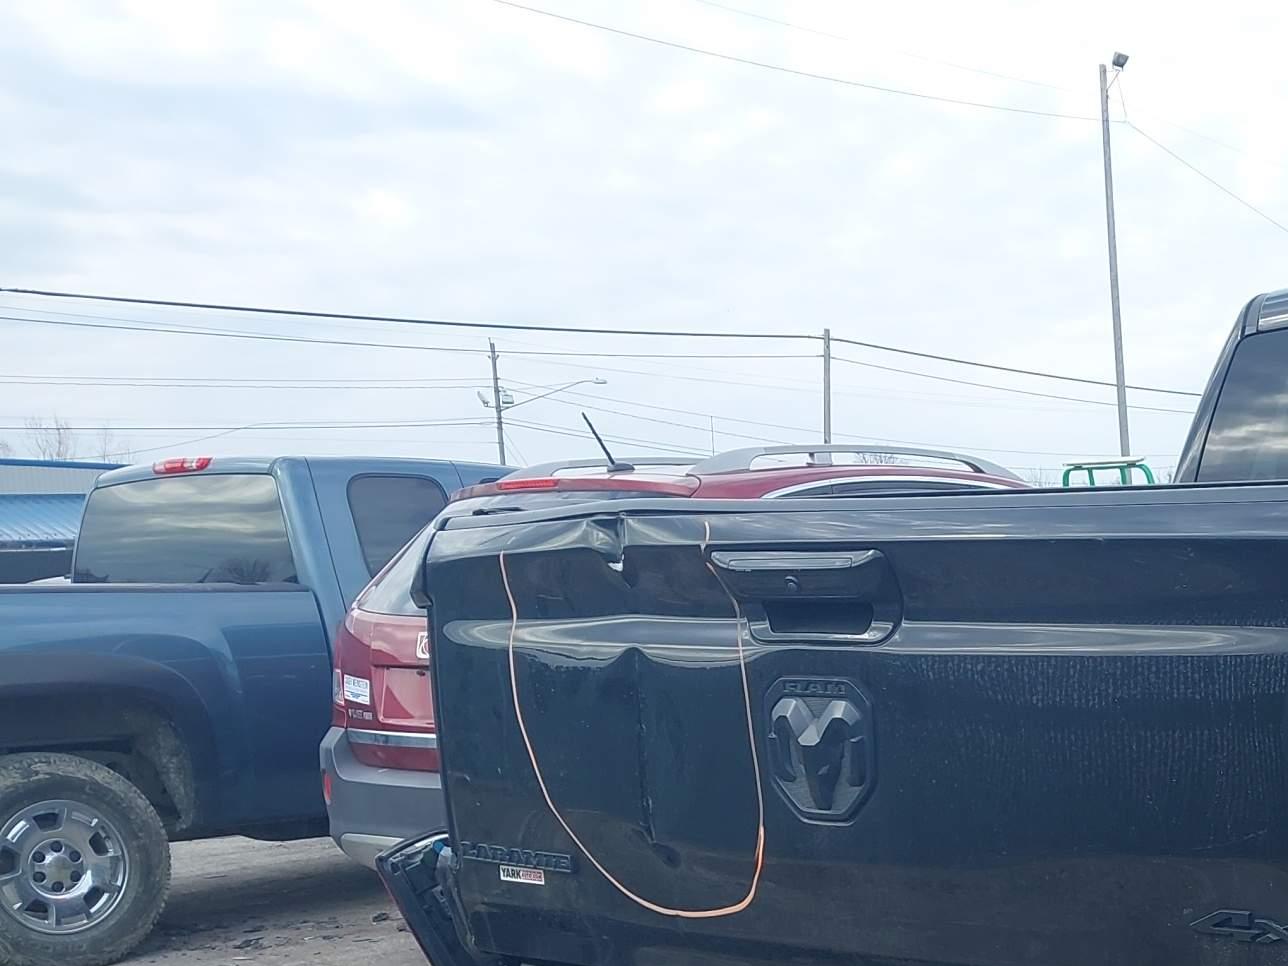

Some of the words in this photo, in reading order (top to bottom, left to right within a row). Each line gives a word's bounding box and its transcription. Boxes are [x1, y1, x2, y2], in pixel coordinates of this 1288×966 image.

[784, 682, 845, 695] RAM
[461, 841, 573, 872] LARAMIE
[501, 867, 521, 880] YARK
